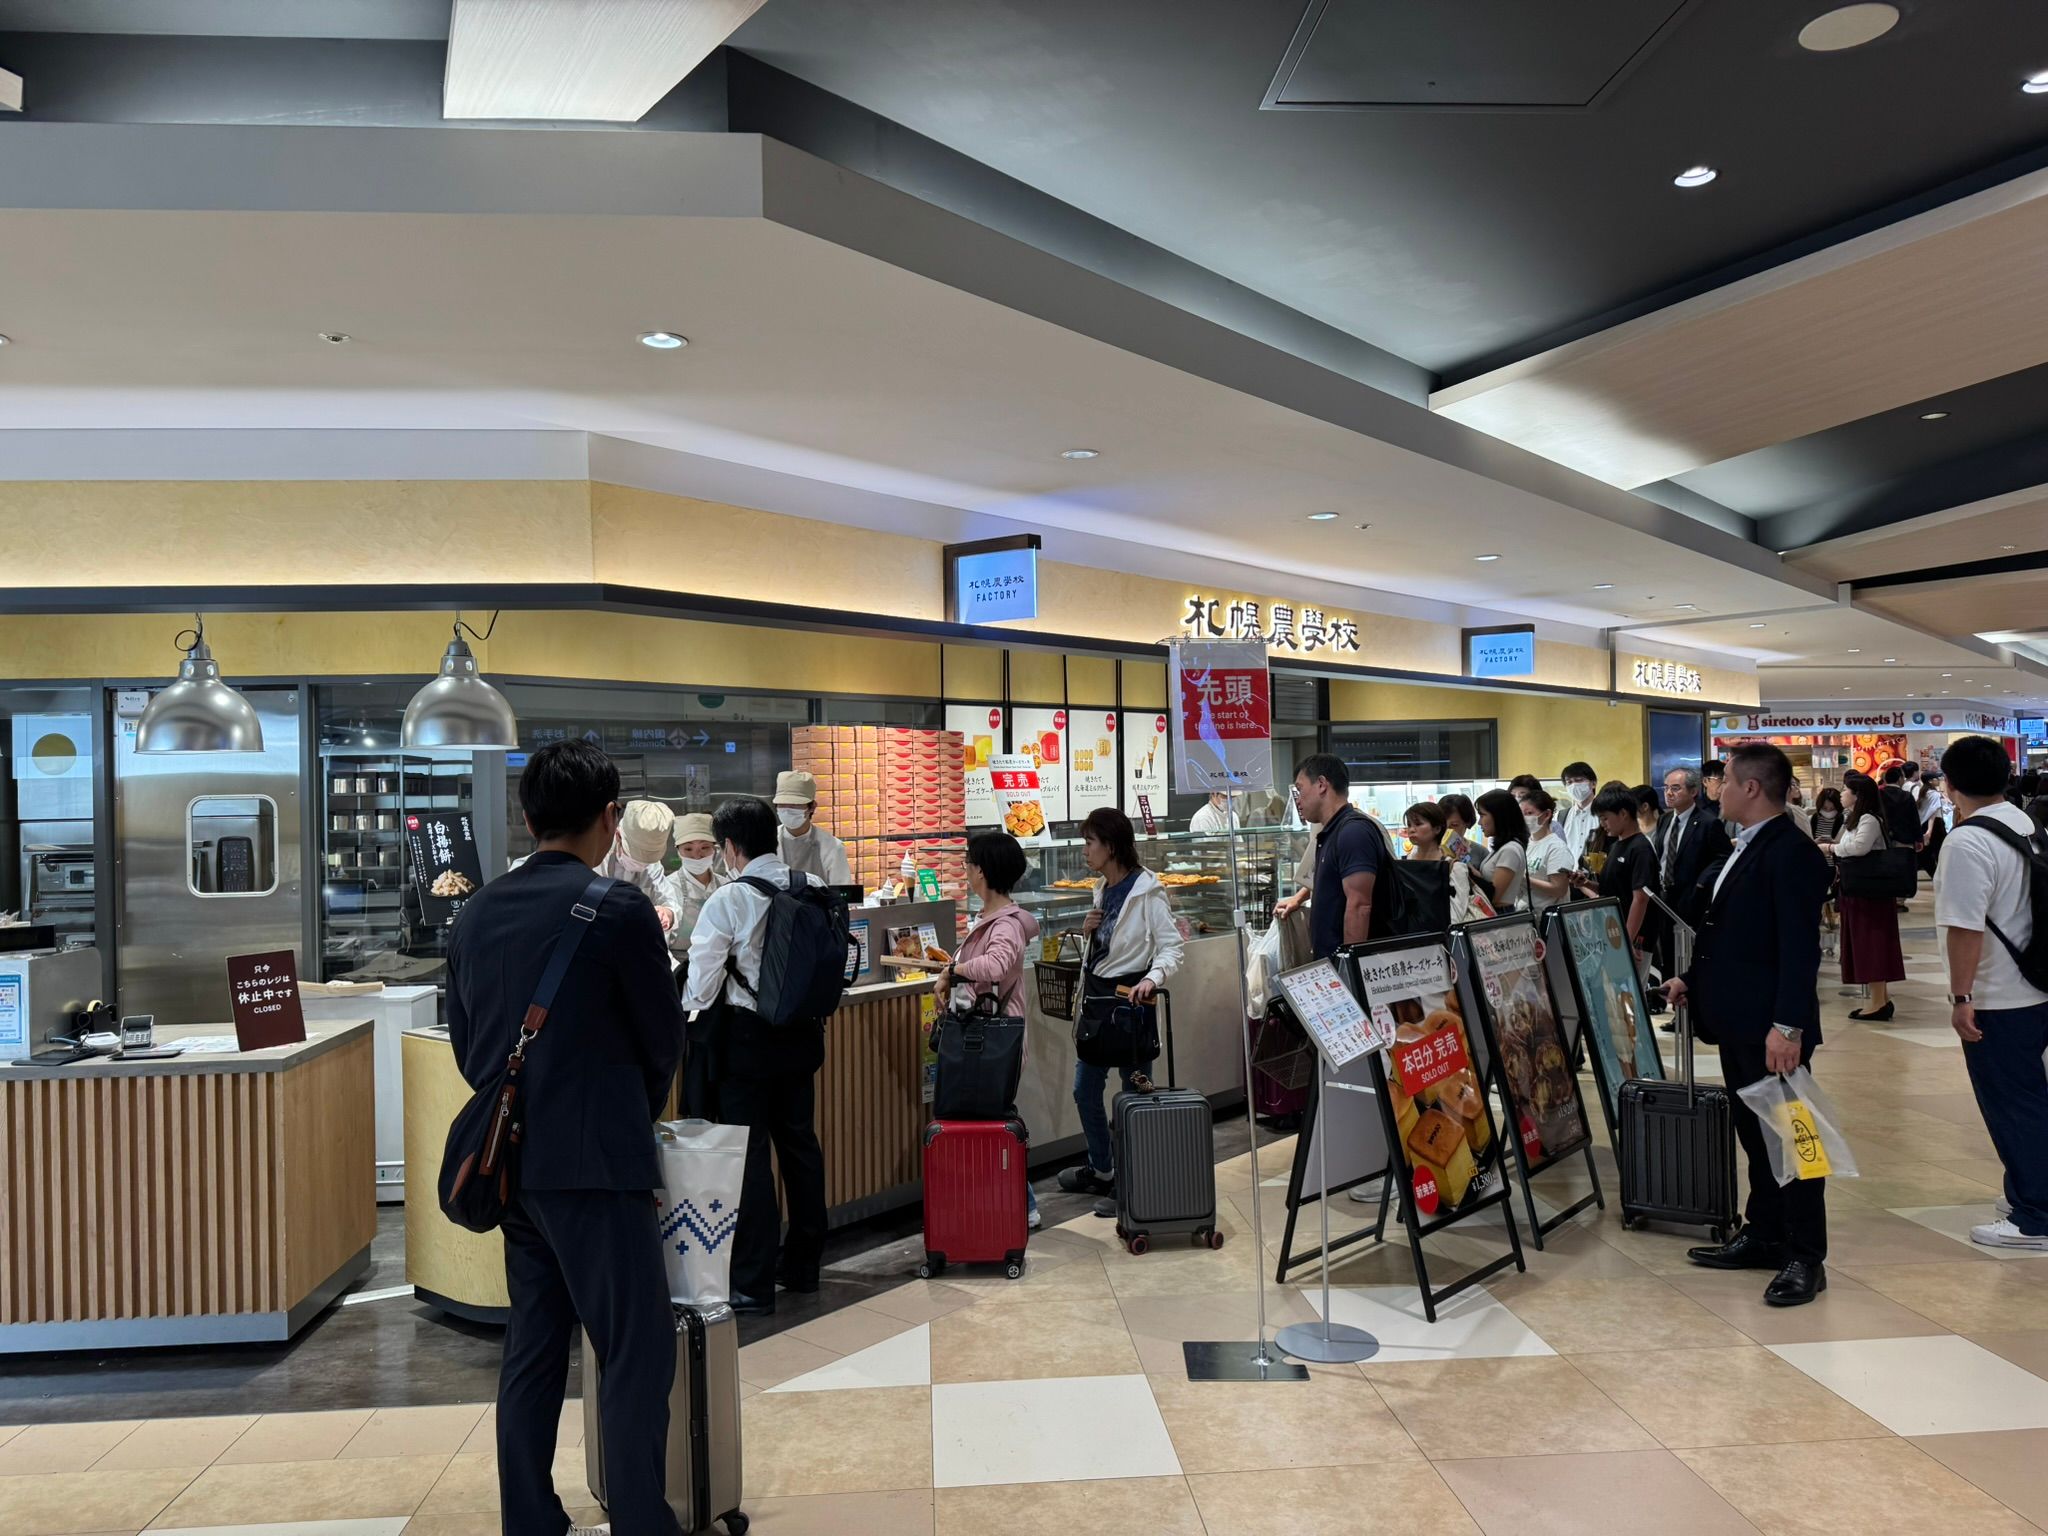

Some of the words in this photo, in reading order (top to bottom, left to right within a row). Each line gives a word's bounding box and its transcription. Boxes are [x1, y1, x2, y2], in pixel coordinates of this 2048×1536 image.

[969, 575, 1025, 590] 札幌農學校
[976, 589, 1017, 603] FACTORY
[1185, 595, 1361, 652] 札幌農學校
[1485, 655, 1518, 664] FACTORY
[1197, 675, 1254, 706] 先頭
[1217, 710, 1237, 718] start
[1239, 710, 1250, 719] of
[1761, 714, 1815, 727] siretoco
[1818, 713, 1842, 729] sky
[1845, 714, 1891, 726] sweets
[1227, 722, 1234, 730] is
[1236, 722, 1258, 730] here.
[1002, 772, 1029, 788] 完売
[1142, 805, 1151, 814] 12
[434, 820, 452, 865] 白揚餅
[254, 964, 271, 975] 只今
[1363, 955, 1443, 983] 焼きたて酪農チーズケーキ
[236, 975, 291, 989] こちらのレジは
[238, 988, 293, 1005] 休止中です
[253, 1003, 282, 1014] CLOSED
[1402, 1043, 1433, 1075] 本日分
[1433, 1032, 1459, 1060] 完売
[1421, 1067, 1438, 1084] SOLD
[1438, 1061, 1450, 1074] OUT
[1415, 1180, 1437, 1199] 新発売
